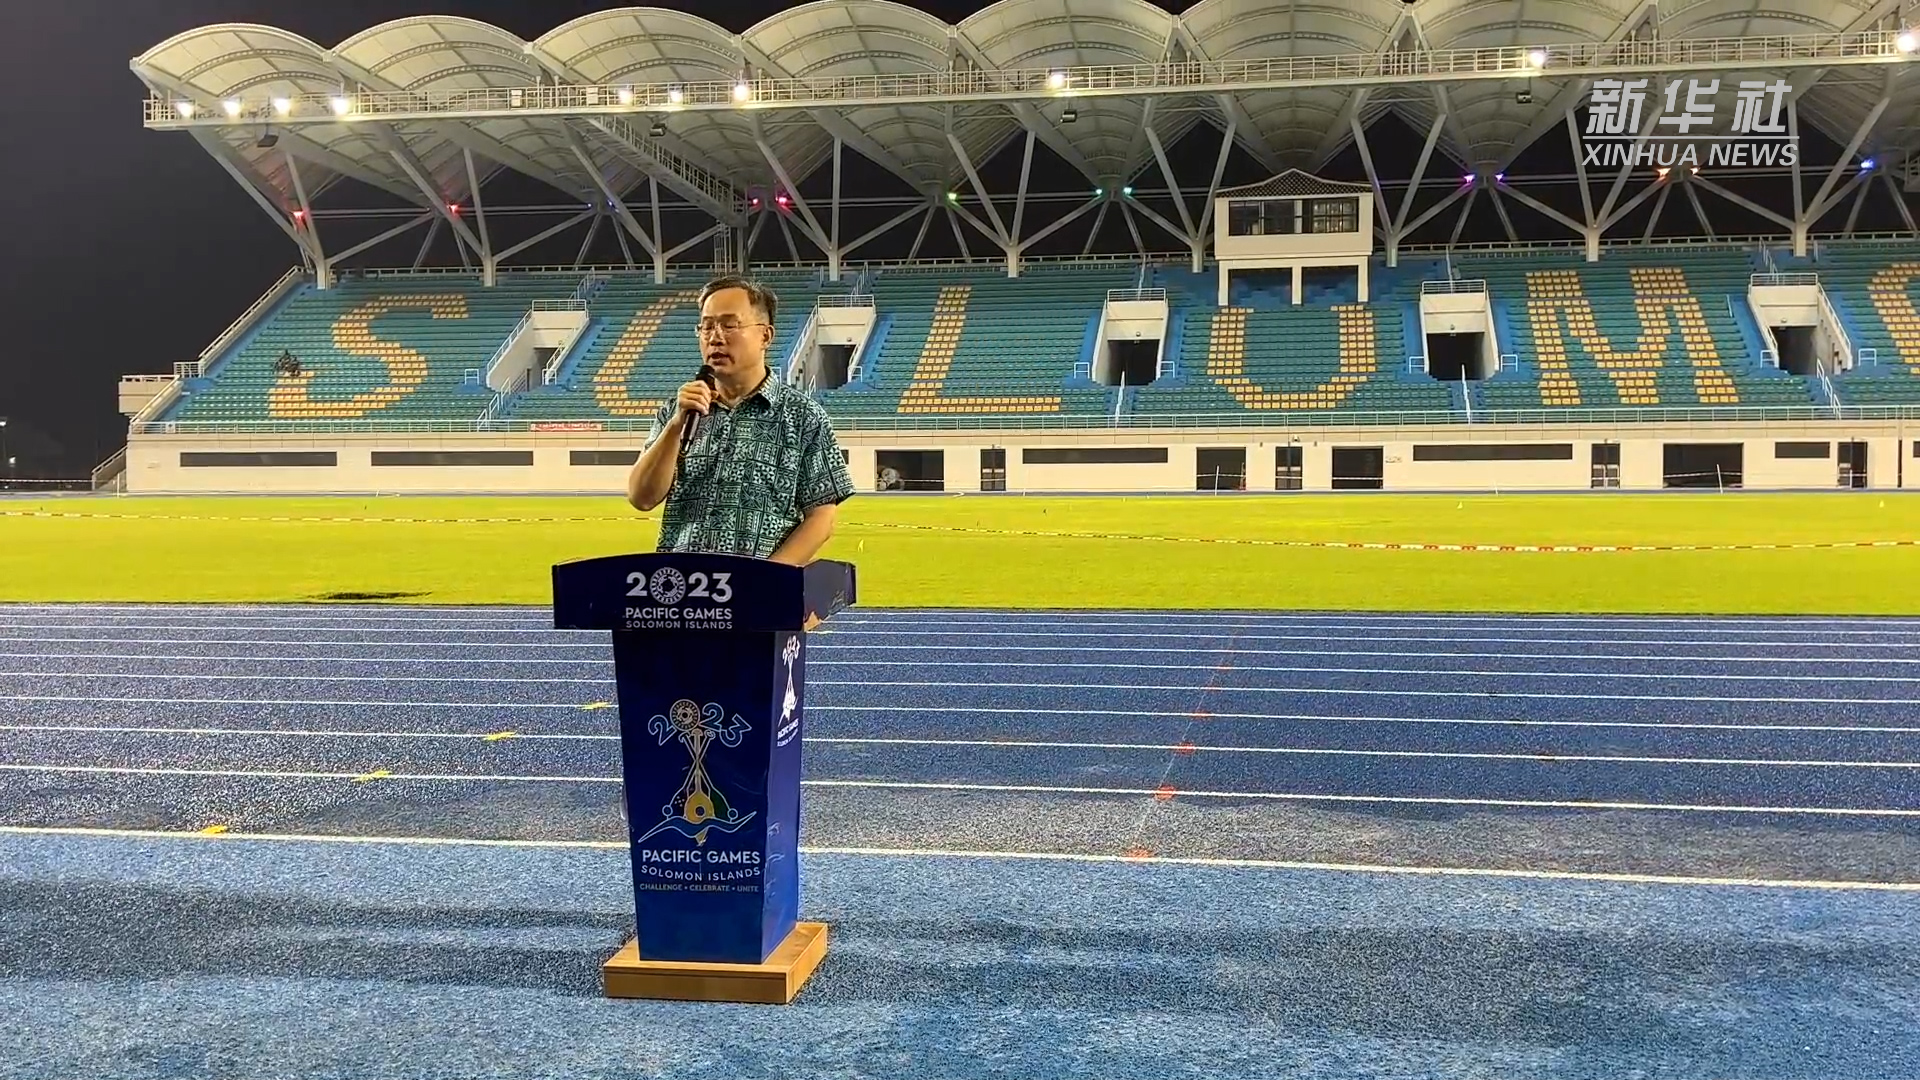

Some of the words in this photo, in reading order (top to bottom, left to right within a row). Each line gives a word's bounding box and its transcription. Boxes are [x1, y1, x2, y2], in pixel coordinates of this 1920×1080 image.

[625, 567, 733, 605] 2023
[625, 607, 680, 619] PACIFIC
[682, 607, 733, 620] GAMES
[625, 620, 681, 629] SOLOMON
[685, 620, 733, 630] ISLANDS
[647, 699, 753, 748] 2023
[642, 849, 702, 863] PACIFIC
[706, 850, 761, 865] GAMES
[641, 864, 703, 882] SOLOMON
[708, 866, 761, 881] ISLANDS
[639, 883, 683, 891] CHALLENGE
[689, 884, 730, 892] CELEBRATE
[736, 885, 760, 893] UNITE
